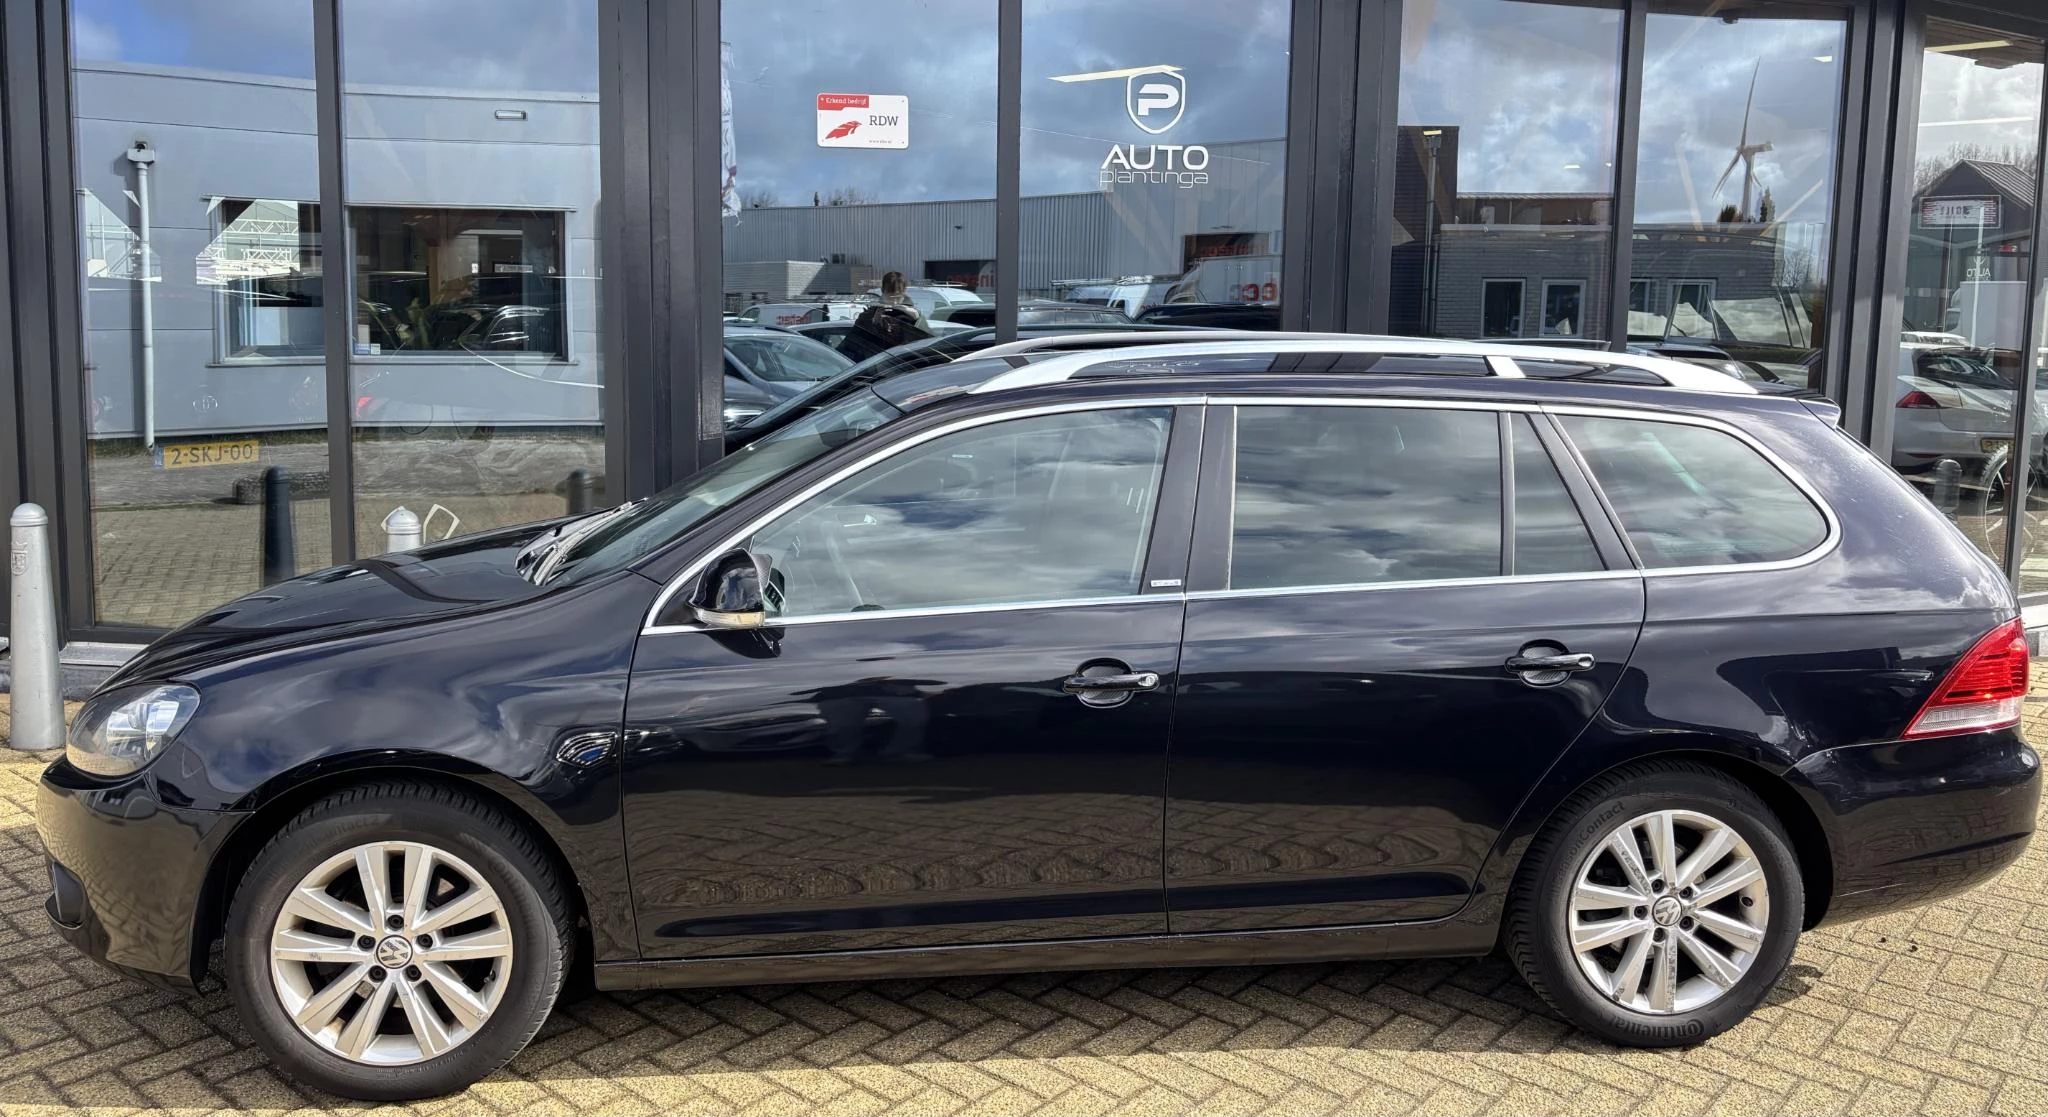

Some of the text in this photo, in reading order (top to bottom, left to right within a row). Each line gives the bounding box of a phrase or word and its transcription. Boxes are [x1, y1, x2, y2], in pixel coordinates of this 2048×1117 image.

[869, 115, 899, 126] RDW
[1101, 143, 1209, 170] AUTO
[1100, 169, 1209, 189] plantinga
[171, 443, 253, 465] 2-SKJ-00
